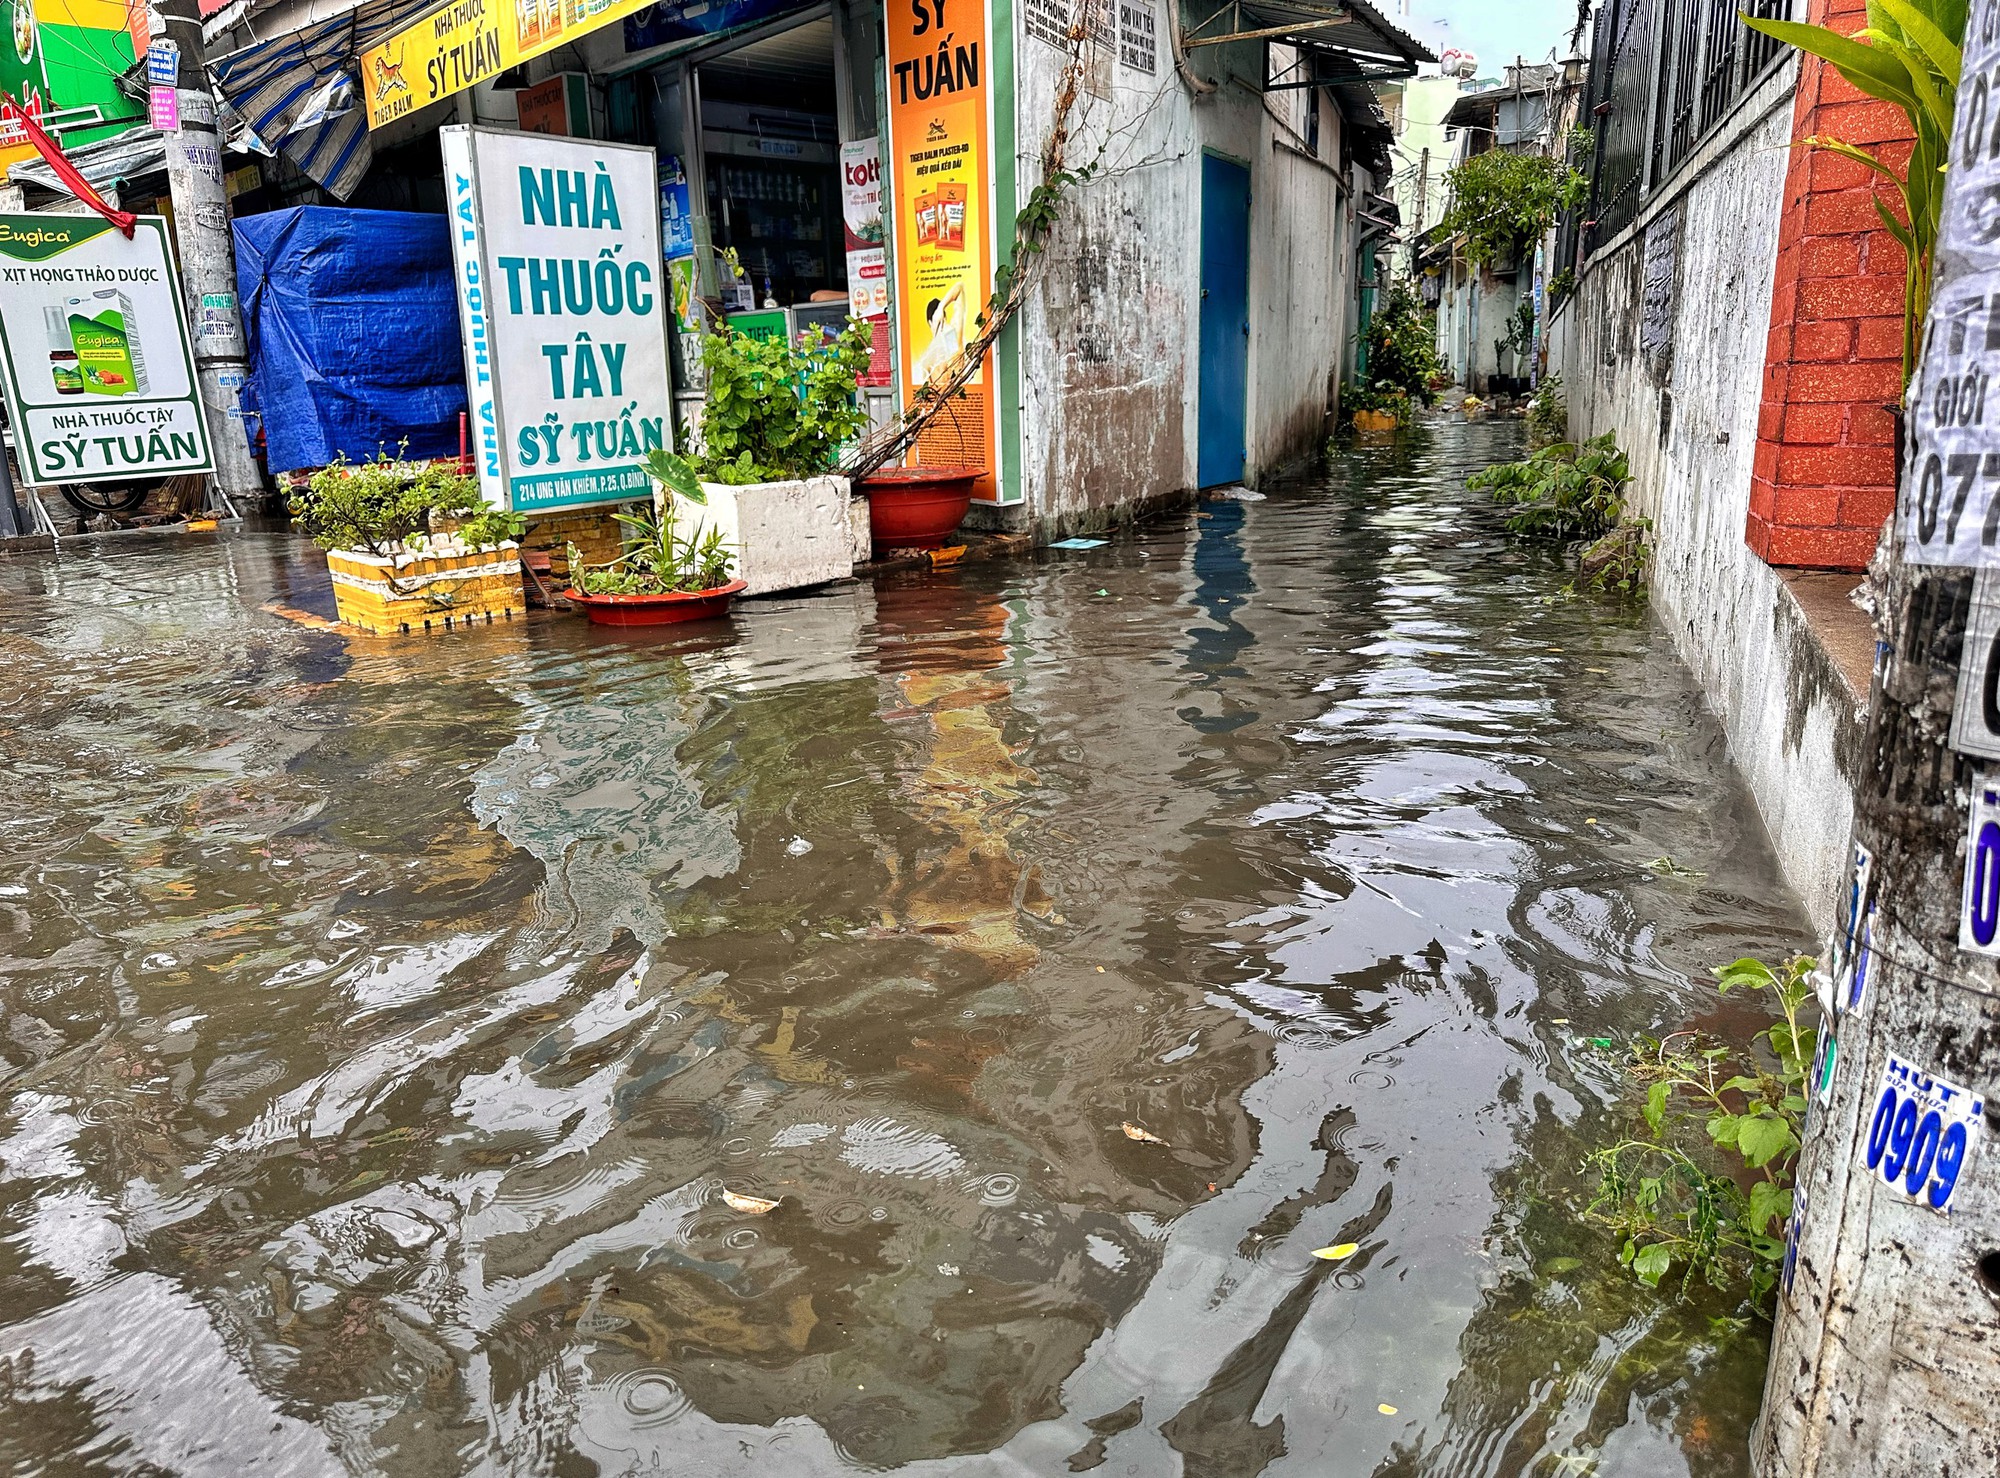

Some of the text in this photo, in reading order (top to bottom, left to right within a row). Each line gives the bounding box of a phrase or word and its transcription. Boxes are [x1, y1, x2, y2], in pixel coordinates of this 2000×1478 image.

[434, 8, 454, 39] NHÀ
[428, 20, 501, 98] SỸ TUẤN
[894, 32, 978, 104] TUẤN
[374, 94, 413, 126] TIGER BALM
[910, 151, 924, 163] TIGER
[924, 148, 938, 161] BALM
[518, 160, 622, 230] NHÀ
[0, 224, 71, 247] Eugica
[2, 264, 159, 285] XỊT HỌNG THẢO DƯỢC
[498, 244, 653, 316] THUỐC
[456, 173, 499, 477] NHÀ THUỐC TÂY
[542, 332, 627, 400] TÂY
[1934, 361, 1989, 428] GIỚI
[42, 424, 198, 470] SỸ TUẤN
[52, 407, 174, 429] NHÀ THUỐC TÂY
[518, 401, 663, 468] SỸ TUẤN
[520, 484, 535, 501] 214
[536, 480, 554, 500] UNG
[554, 476, 571, 498] VĂN
[1867, 1086, 1967, 1208] 0909
